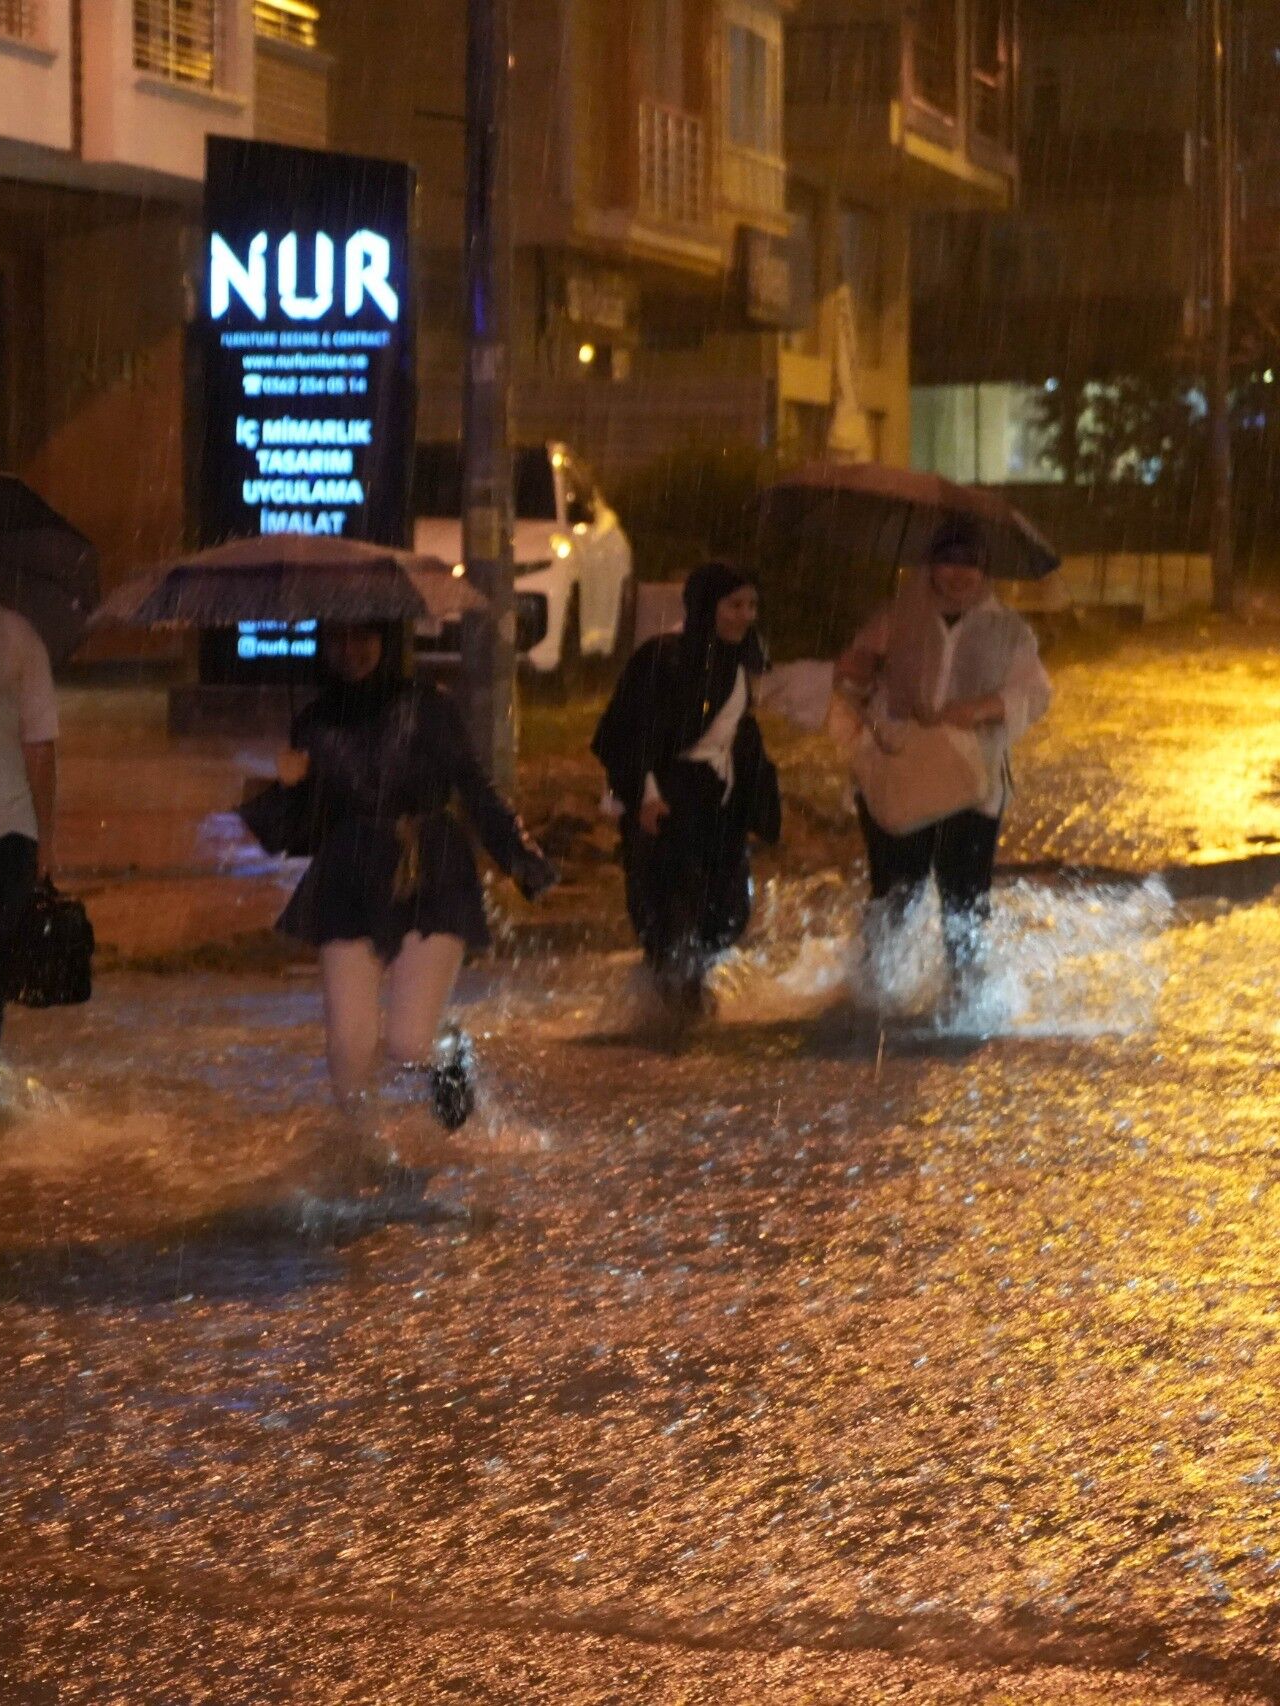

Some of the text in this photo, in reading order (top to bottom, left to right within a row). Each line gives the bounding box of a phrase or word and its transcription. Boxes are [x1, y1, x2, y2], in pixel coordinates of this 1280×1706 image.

[210, 229, 399, 322] NUR
[236, 415, 372, 450] İÇ MİMARLIK
[256, 449, 353, 475] TASARIM
[243, 479, 363, 504] UYGULAMA
[260, 507, 345, 534] İMALAT
